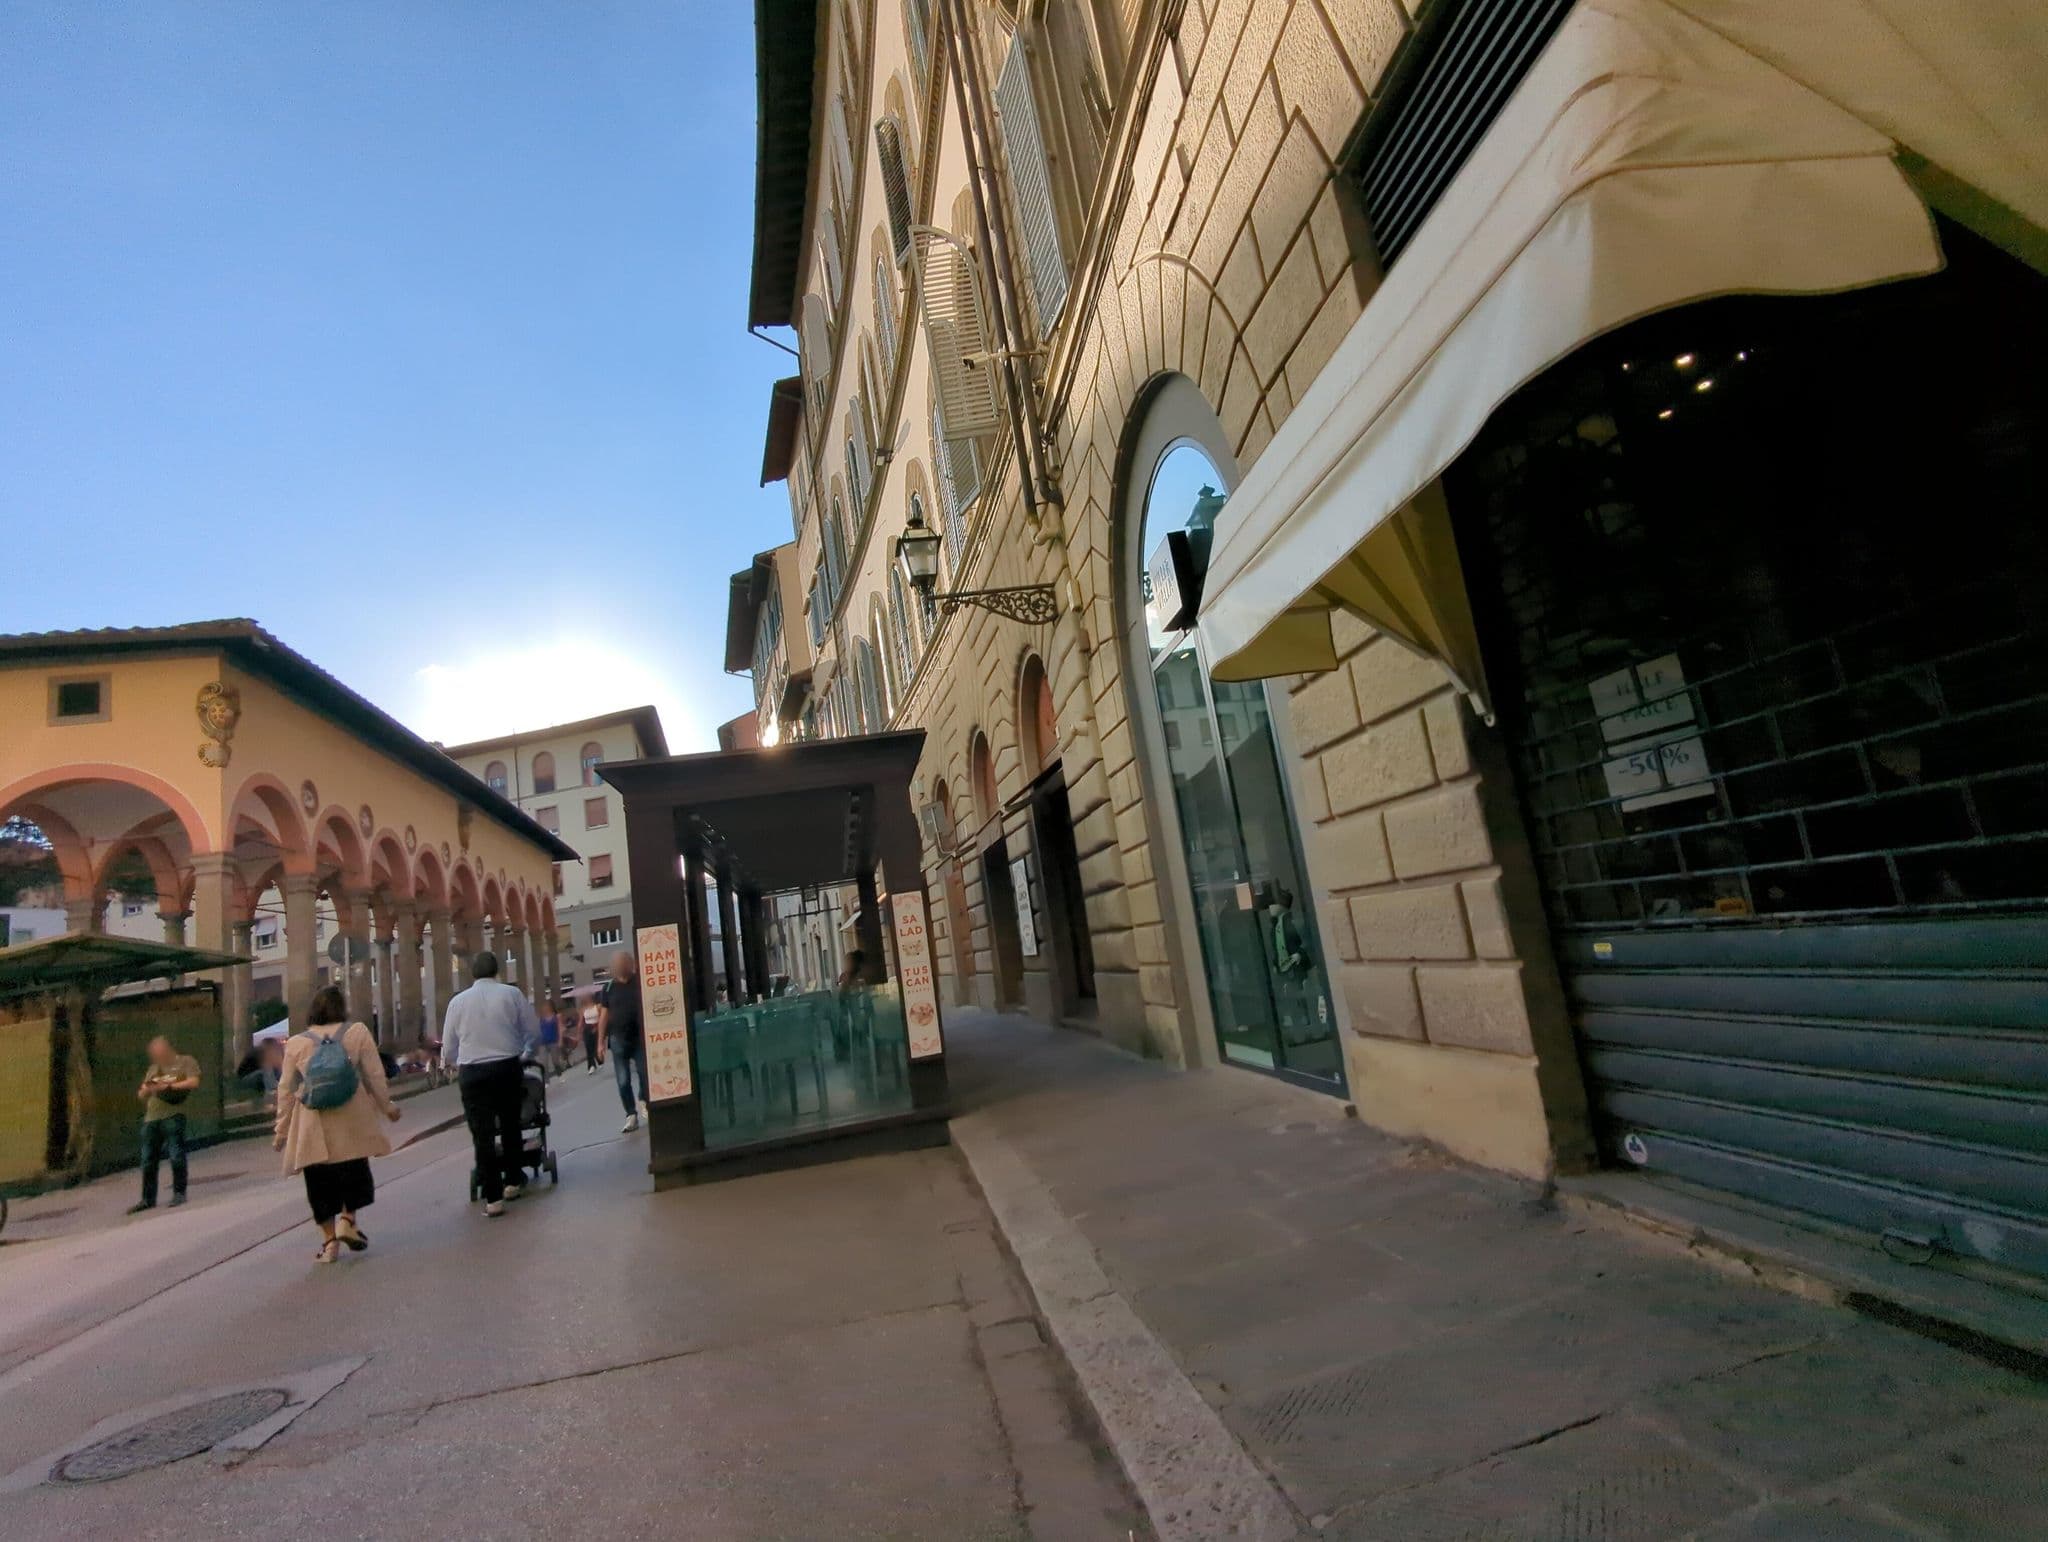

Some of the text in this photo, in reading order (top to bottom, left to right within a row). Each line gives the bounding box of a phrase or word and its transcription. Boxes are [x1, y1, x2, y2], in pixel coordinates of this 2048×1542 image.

[1619, 744, 1690, 777] -50%
[902, 914, 917, 925] SA
[900, 926, 923, 937] LAD
[644, 949, 676, 962] HAM
[645, 961, 676, 975] BUR
[904, 965, 929, 977] TUS
[647, 974, 678, 988] GER
[906, 976, 929, 987] CAN
[649, 1030, 684, 1043] TAPAS
